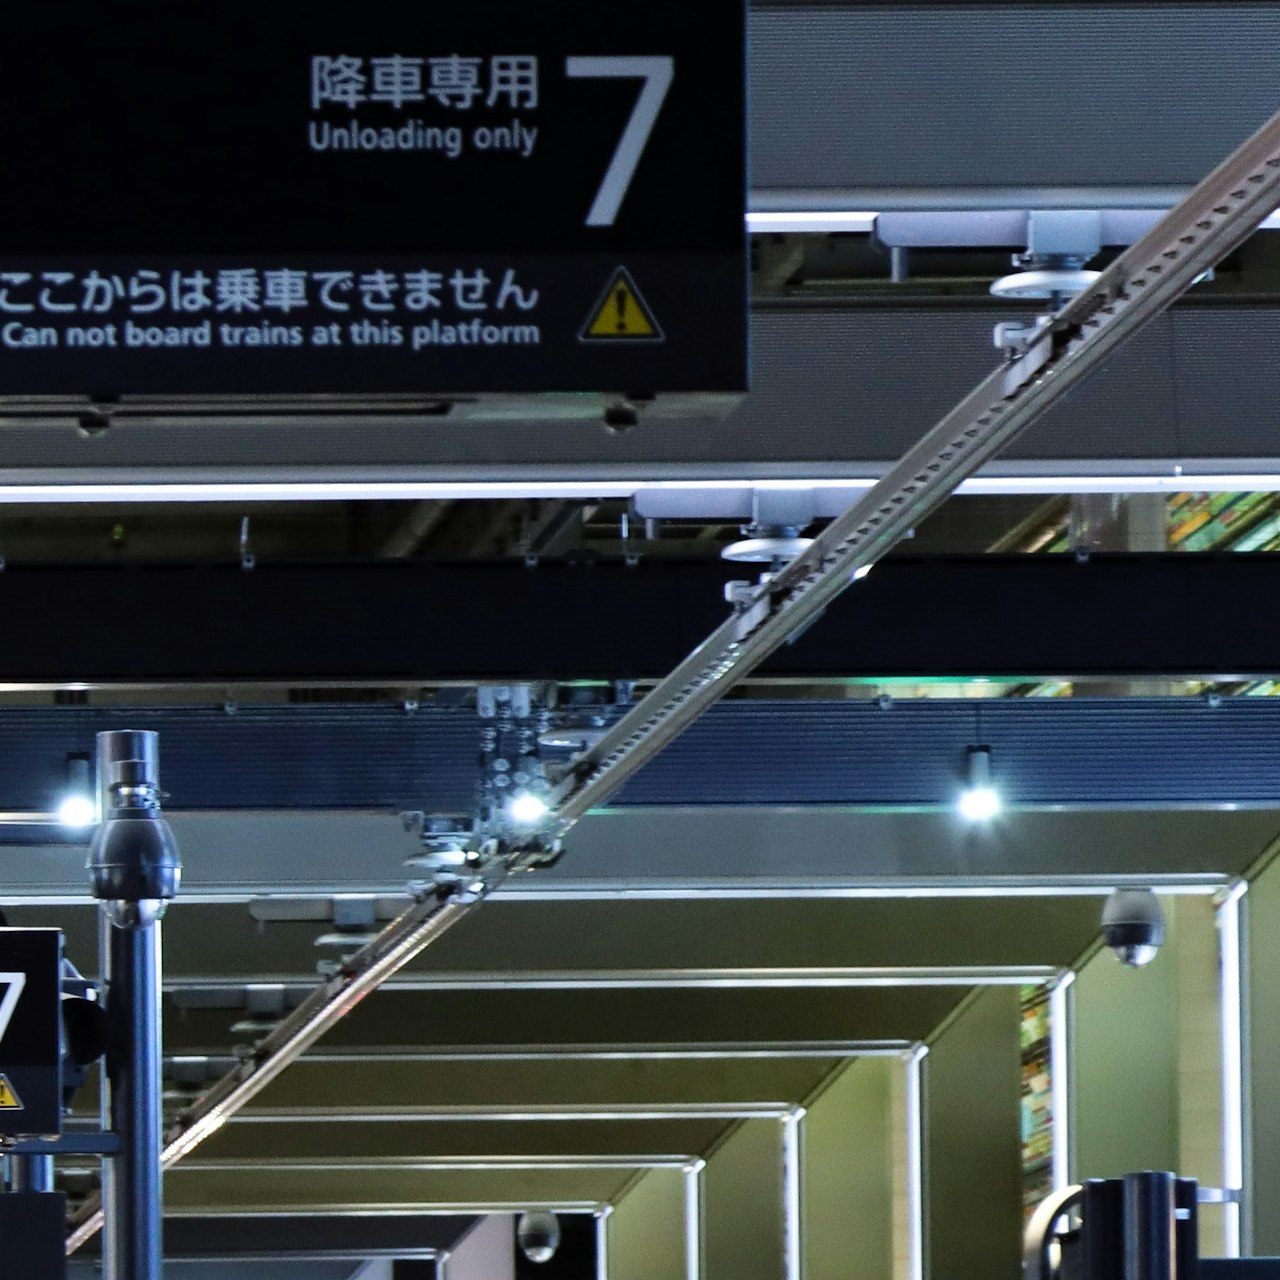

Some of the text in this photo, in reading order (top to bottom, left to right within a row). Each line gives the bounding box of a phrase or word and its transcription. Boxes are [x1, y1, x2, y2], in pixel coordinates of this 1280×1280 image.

[310, 54, 539, 109] 降車専用
[309, 120, 538, 157] Unloading only
[565, 55, 675, 226] 7
[1, 318, 540, 351] Can not board trains at this platform
